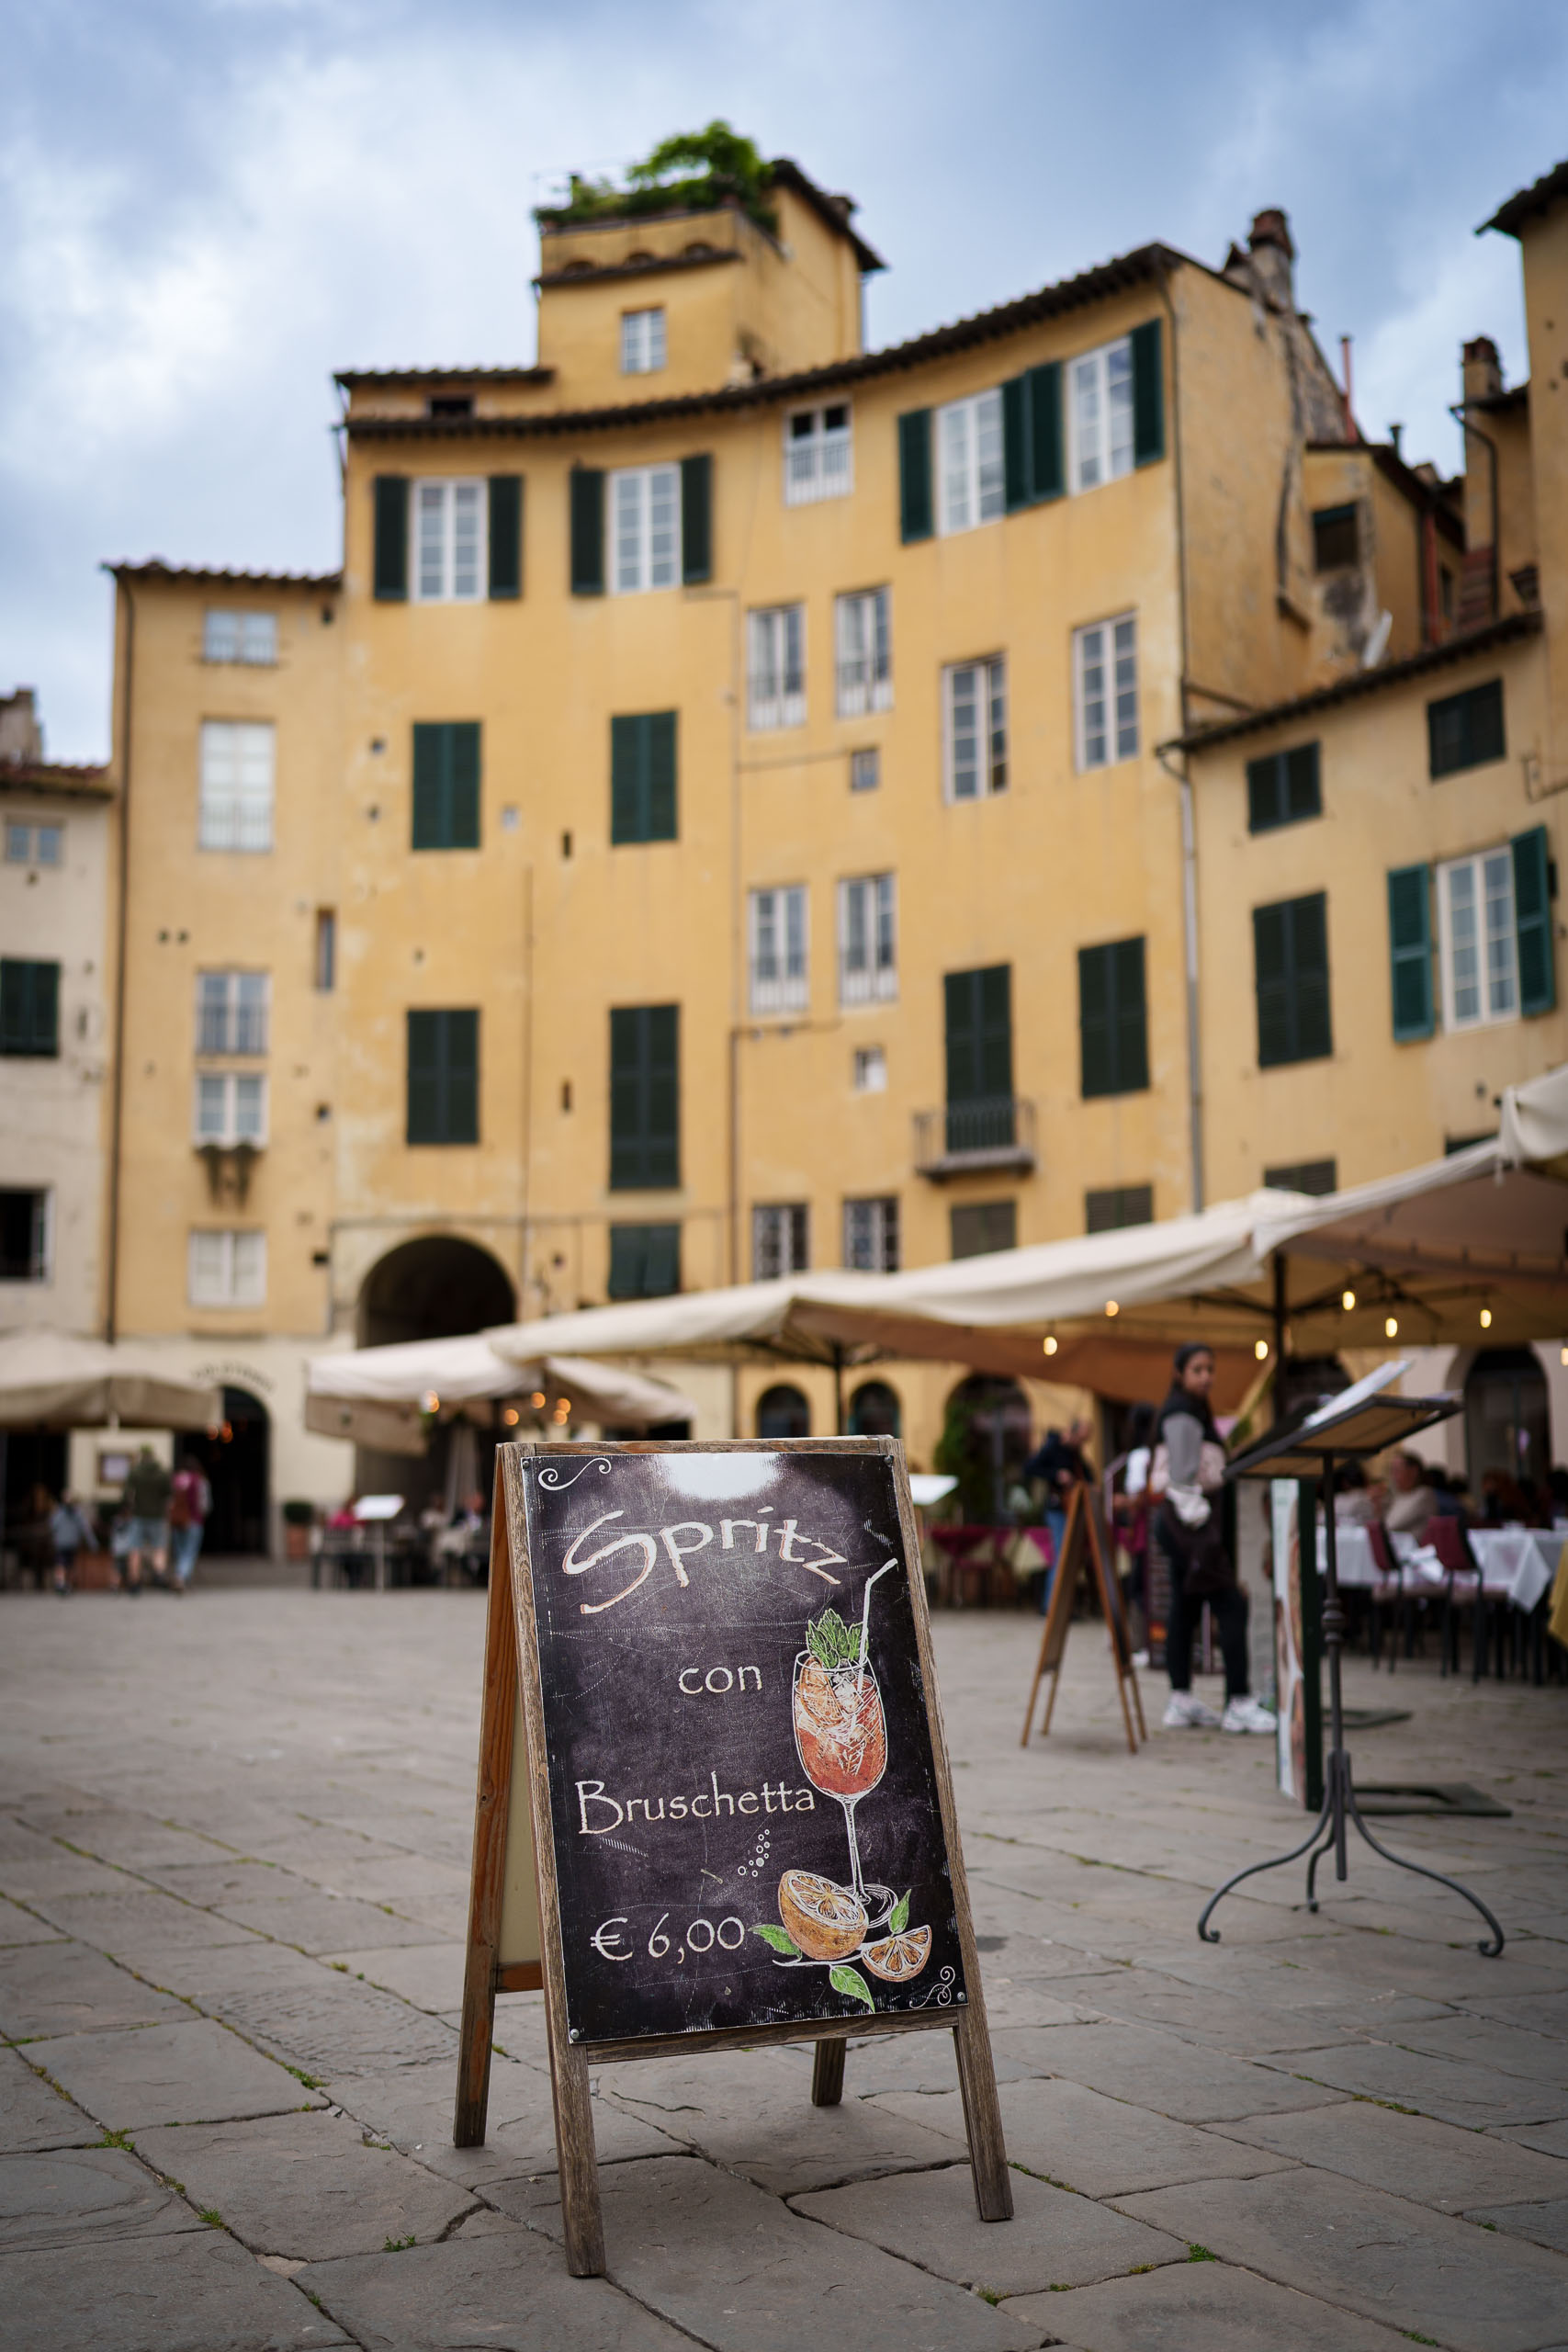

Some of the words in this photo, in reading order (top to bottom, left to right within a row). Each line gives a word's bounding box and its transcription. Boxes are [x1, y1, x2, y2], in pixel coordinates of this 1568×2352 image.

[563, 1508, 847, 1614] Spritz
[678, 1665, 762, 1694] con
[575, 1770, 816, 1835] Bruschetta
[590, 1917, 634, 1961] €
[648, 1913, 746, 1964] 6,00
